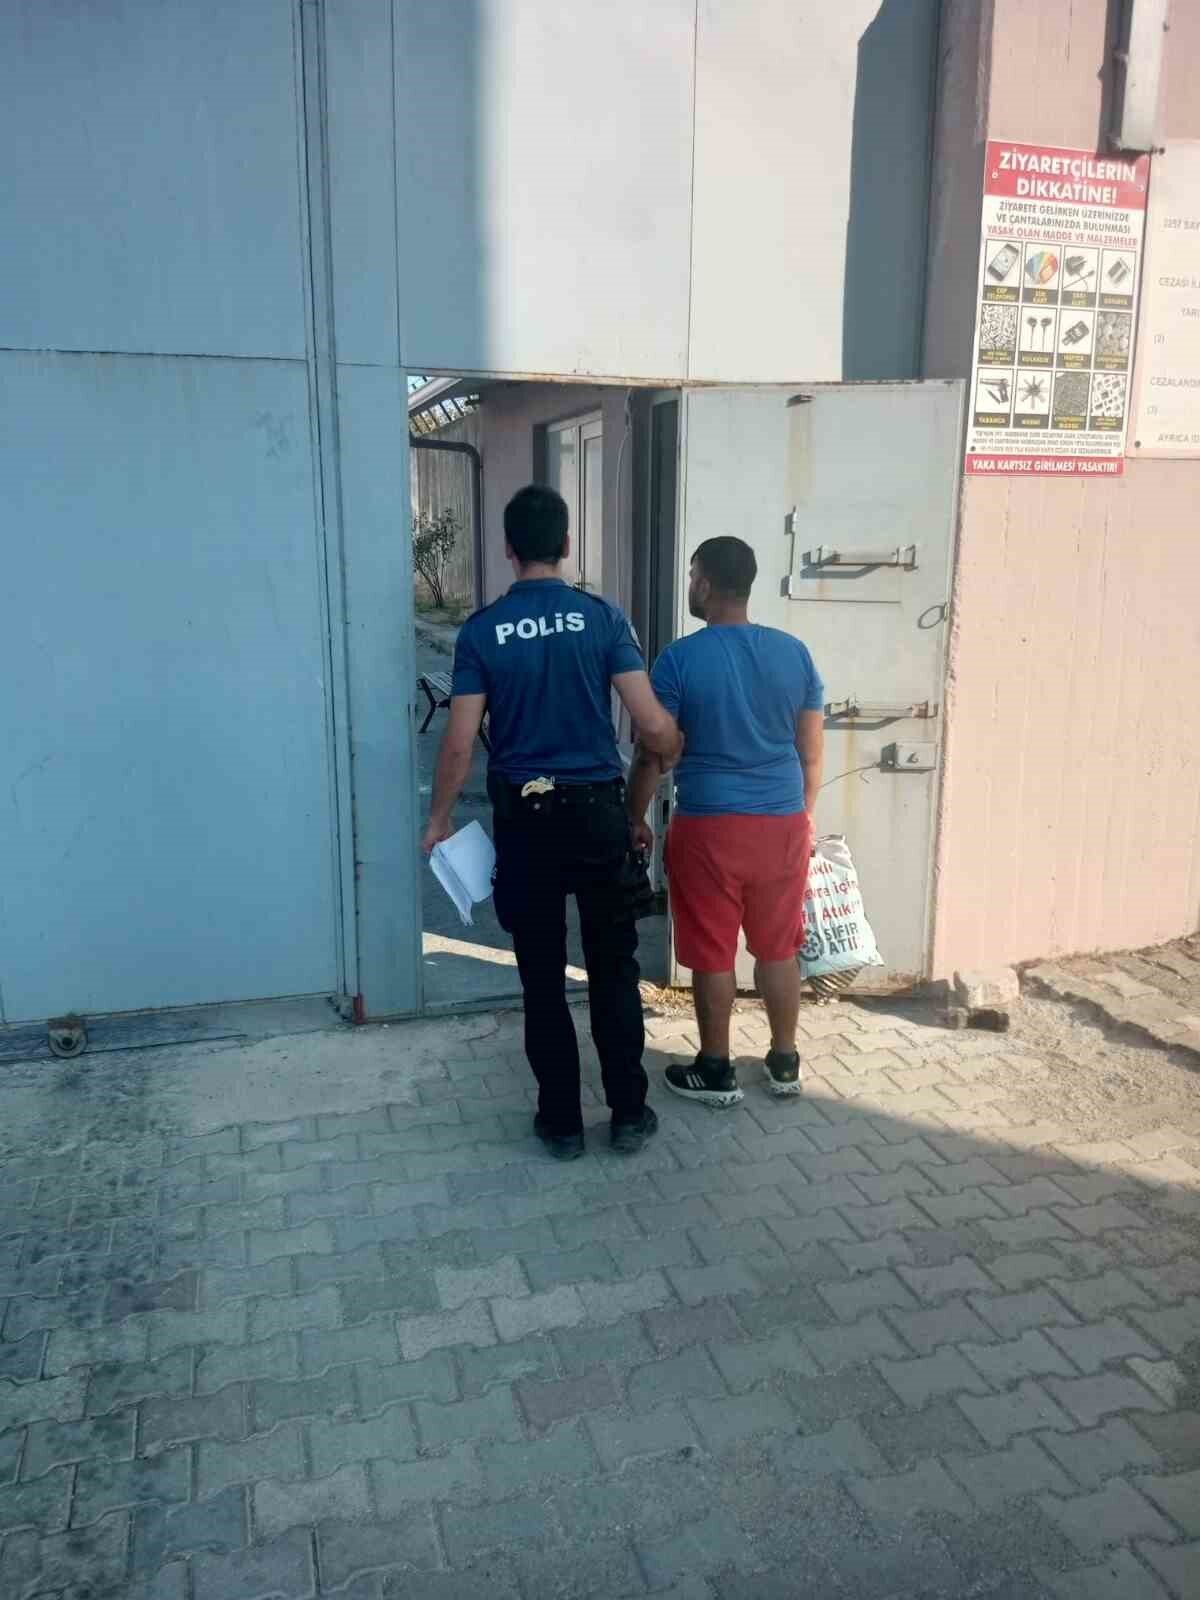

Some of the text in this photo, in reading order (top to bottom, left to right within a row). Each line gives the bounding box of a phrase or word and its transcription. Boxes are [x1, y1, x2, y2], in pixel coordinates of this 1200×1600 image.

[999, 148, 1136, 182] ZİYARETÇİLERİN
[1016, 177, 1117, 204] DİKKATİNE!
[1000, 201, 1036, 213] ZİYARETE
[996, 213, 1008, 223] VE
[987, 224, 1014, 235] YASAK
[1017, 227, 1040, 238] OLAN
[1043, 230, 1072, 241] MADDE
[972, 460, 995, 471] YAKA
[997, 460, 1032, 472] KARTSIZ
[1034, 459, 1075, 472] GİRİLMESİ
